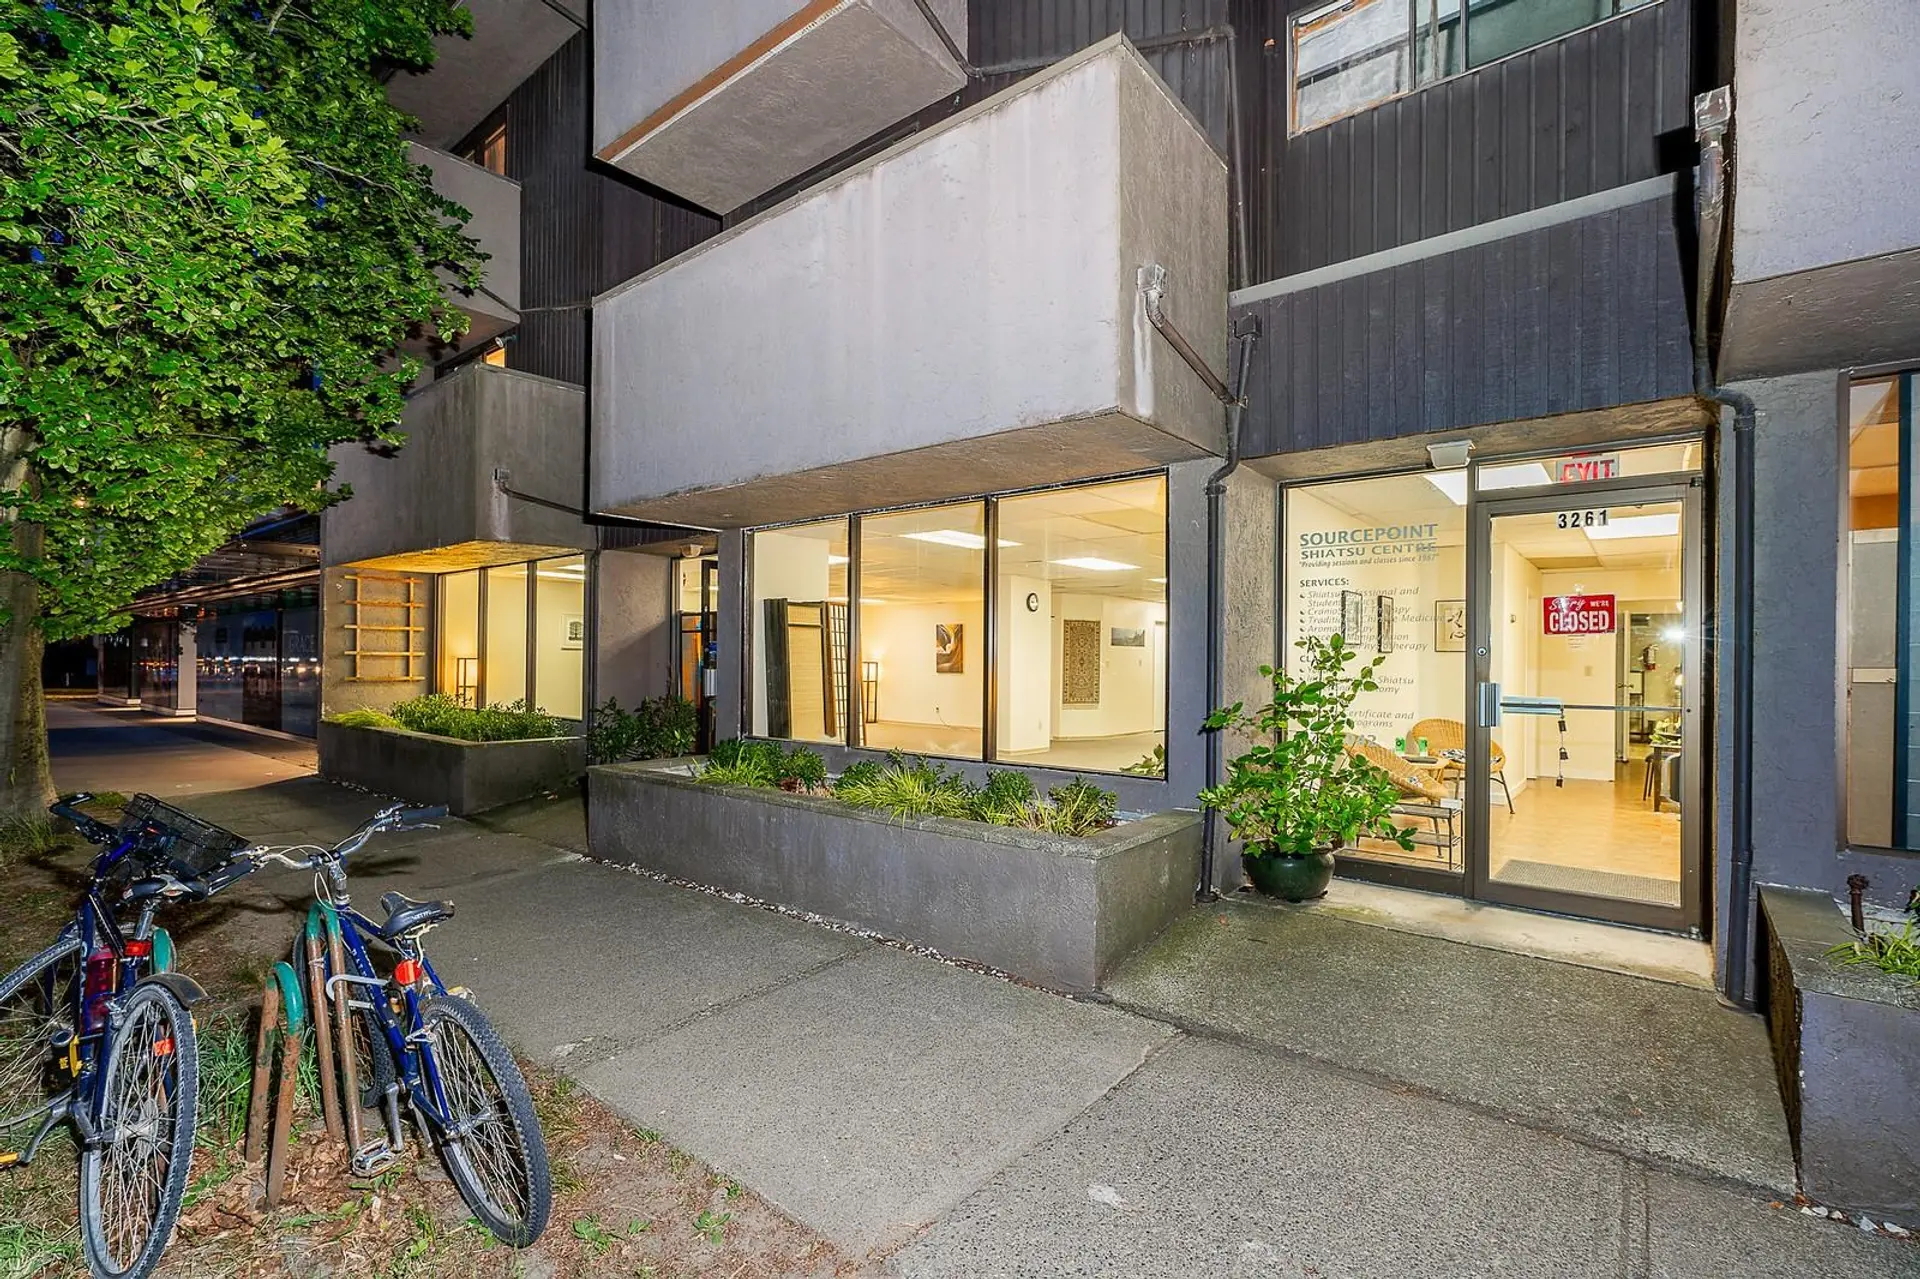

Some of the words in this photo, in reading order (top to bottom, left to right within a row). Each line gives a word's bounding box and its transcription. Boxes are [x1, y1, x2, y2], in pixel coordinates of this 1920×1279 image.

[1558, 509, 1607, 529] 3261
[1299, 523, 1438, 546] SOURCEPOINT
[1301, 546, 1366, 560] SHIATSU
[1371, 541, 1437, 556] CENTRE
[1332, 558, 1359, 567] sessions
[1359, 556, 1373, 565] and
[1373, 555, 1397, 564] classes
[1398, 554, 1416, 563] since
[1300, 577, 1349, 588] SERVICES:
[1307, 590, 1342, 599] Shiatsu
[1400, 586, 1420, 596] and
[1549, 610, 1610, 633] CLOSED
[1377, 674, 1414, 684] Shiatsu
[1394, 711, 1415, 720] and
